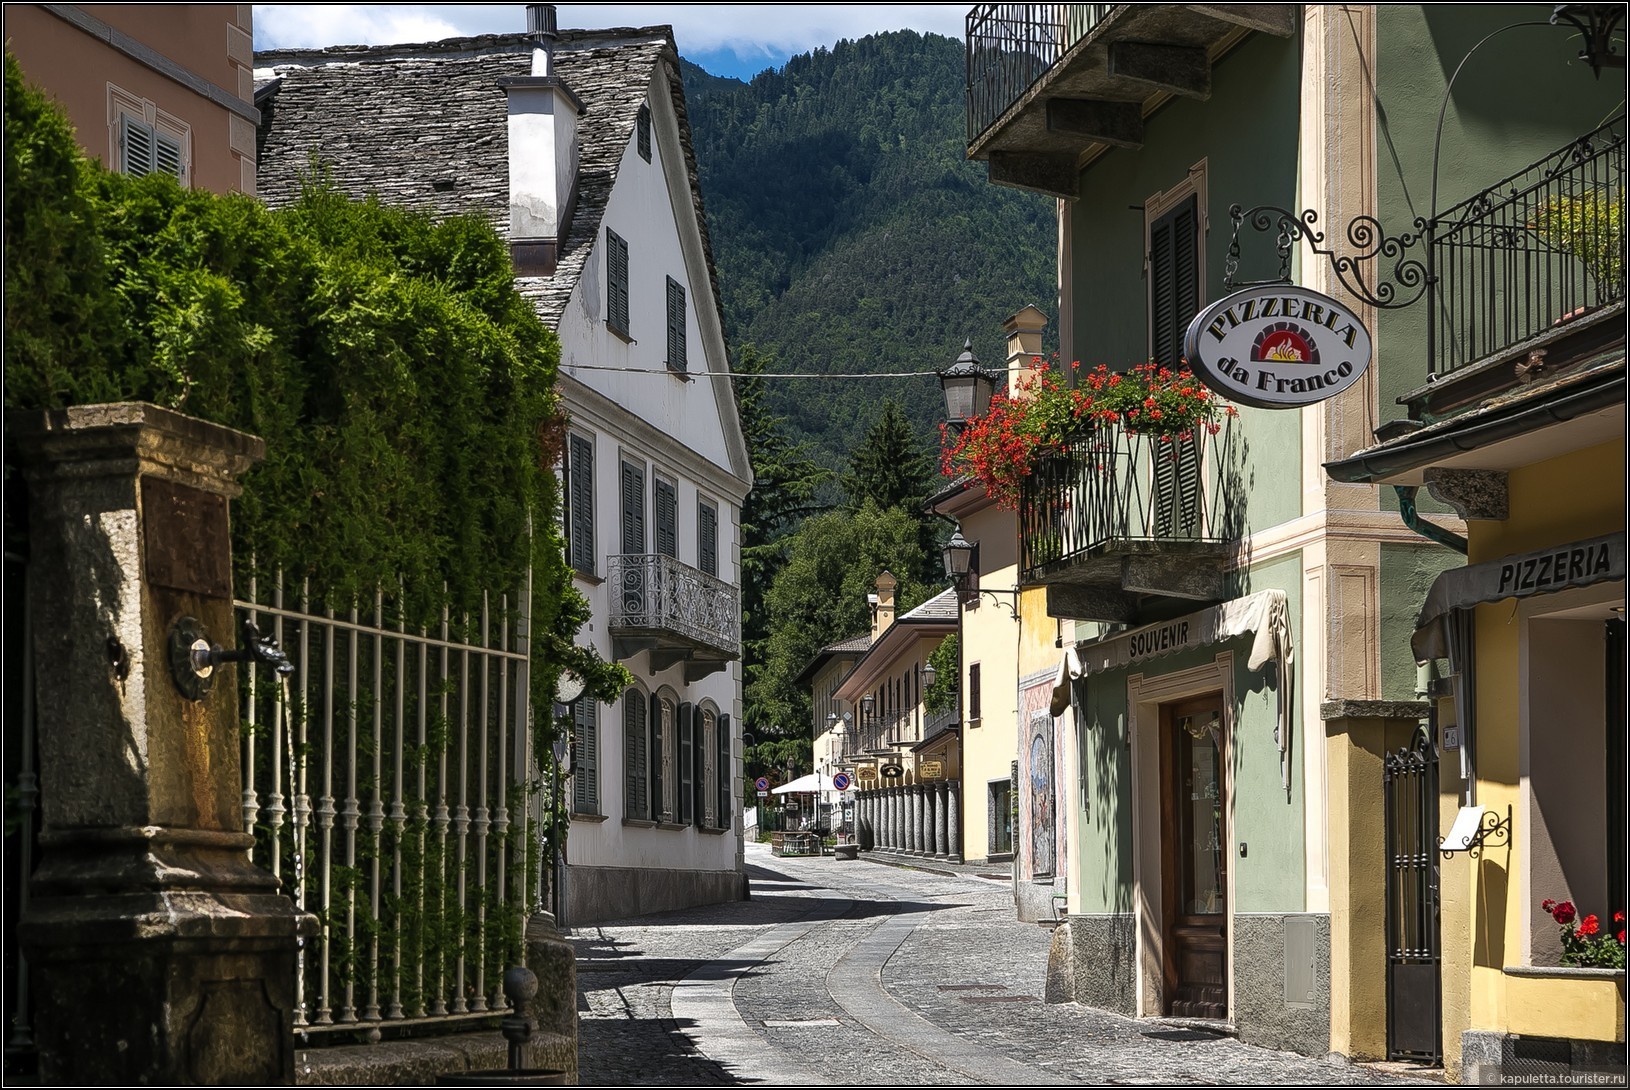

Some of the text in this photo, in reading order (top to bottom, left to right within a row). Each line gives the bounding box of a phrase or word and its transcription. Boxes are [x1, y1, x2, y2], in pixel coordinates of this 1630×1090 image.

[1206, 297, 1358, 350] PIZZERIA
[1217, 357, 1353, 393] da Franco
[1497, 543, 1611, 594] PIZZERIA
[1130, 621, 1189, 657] SOUVENIR
